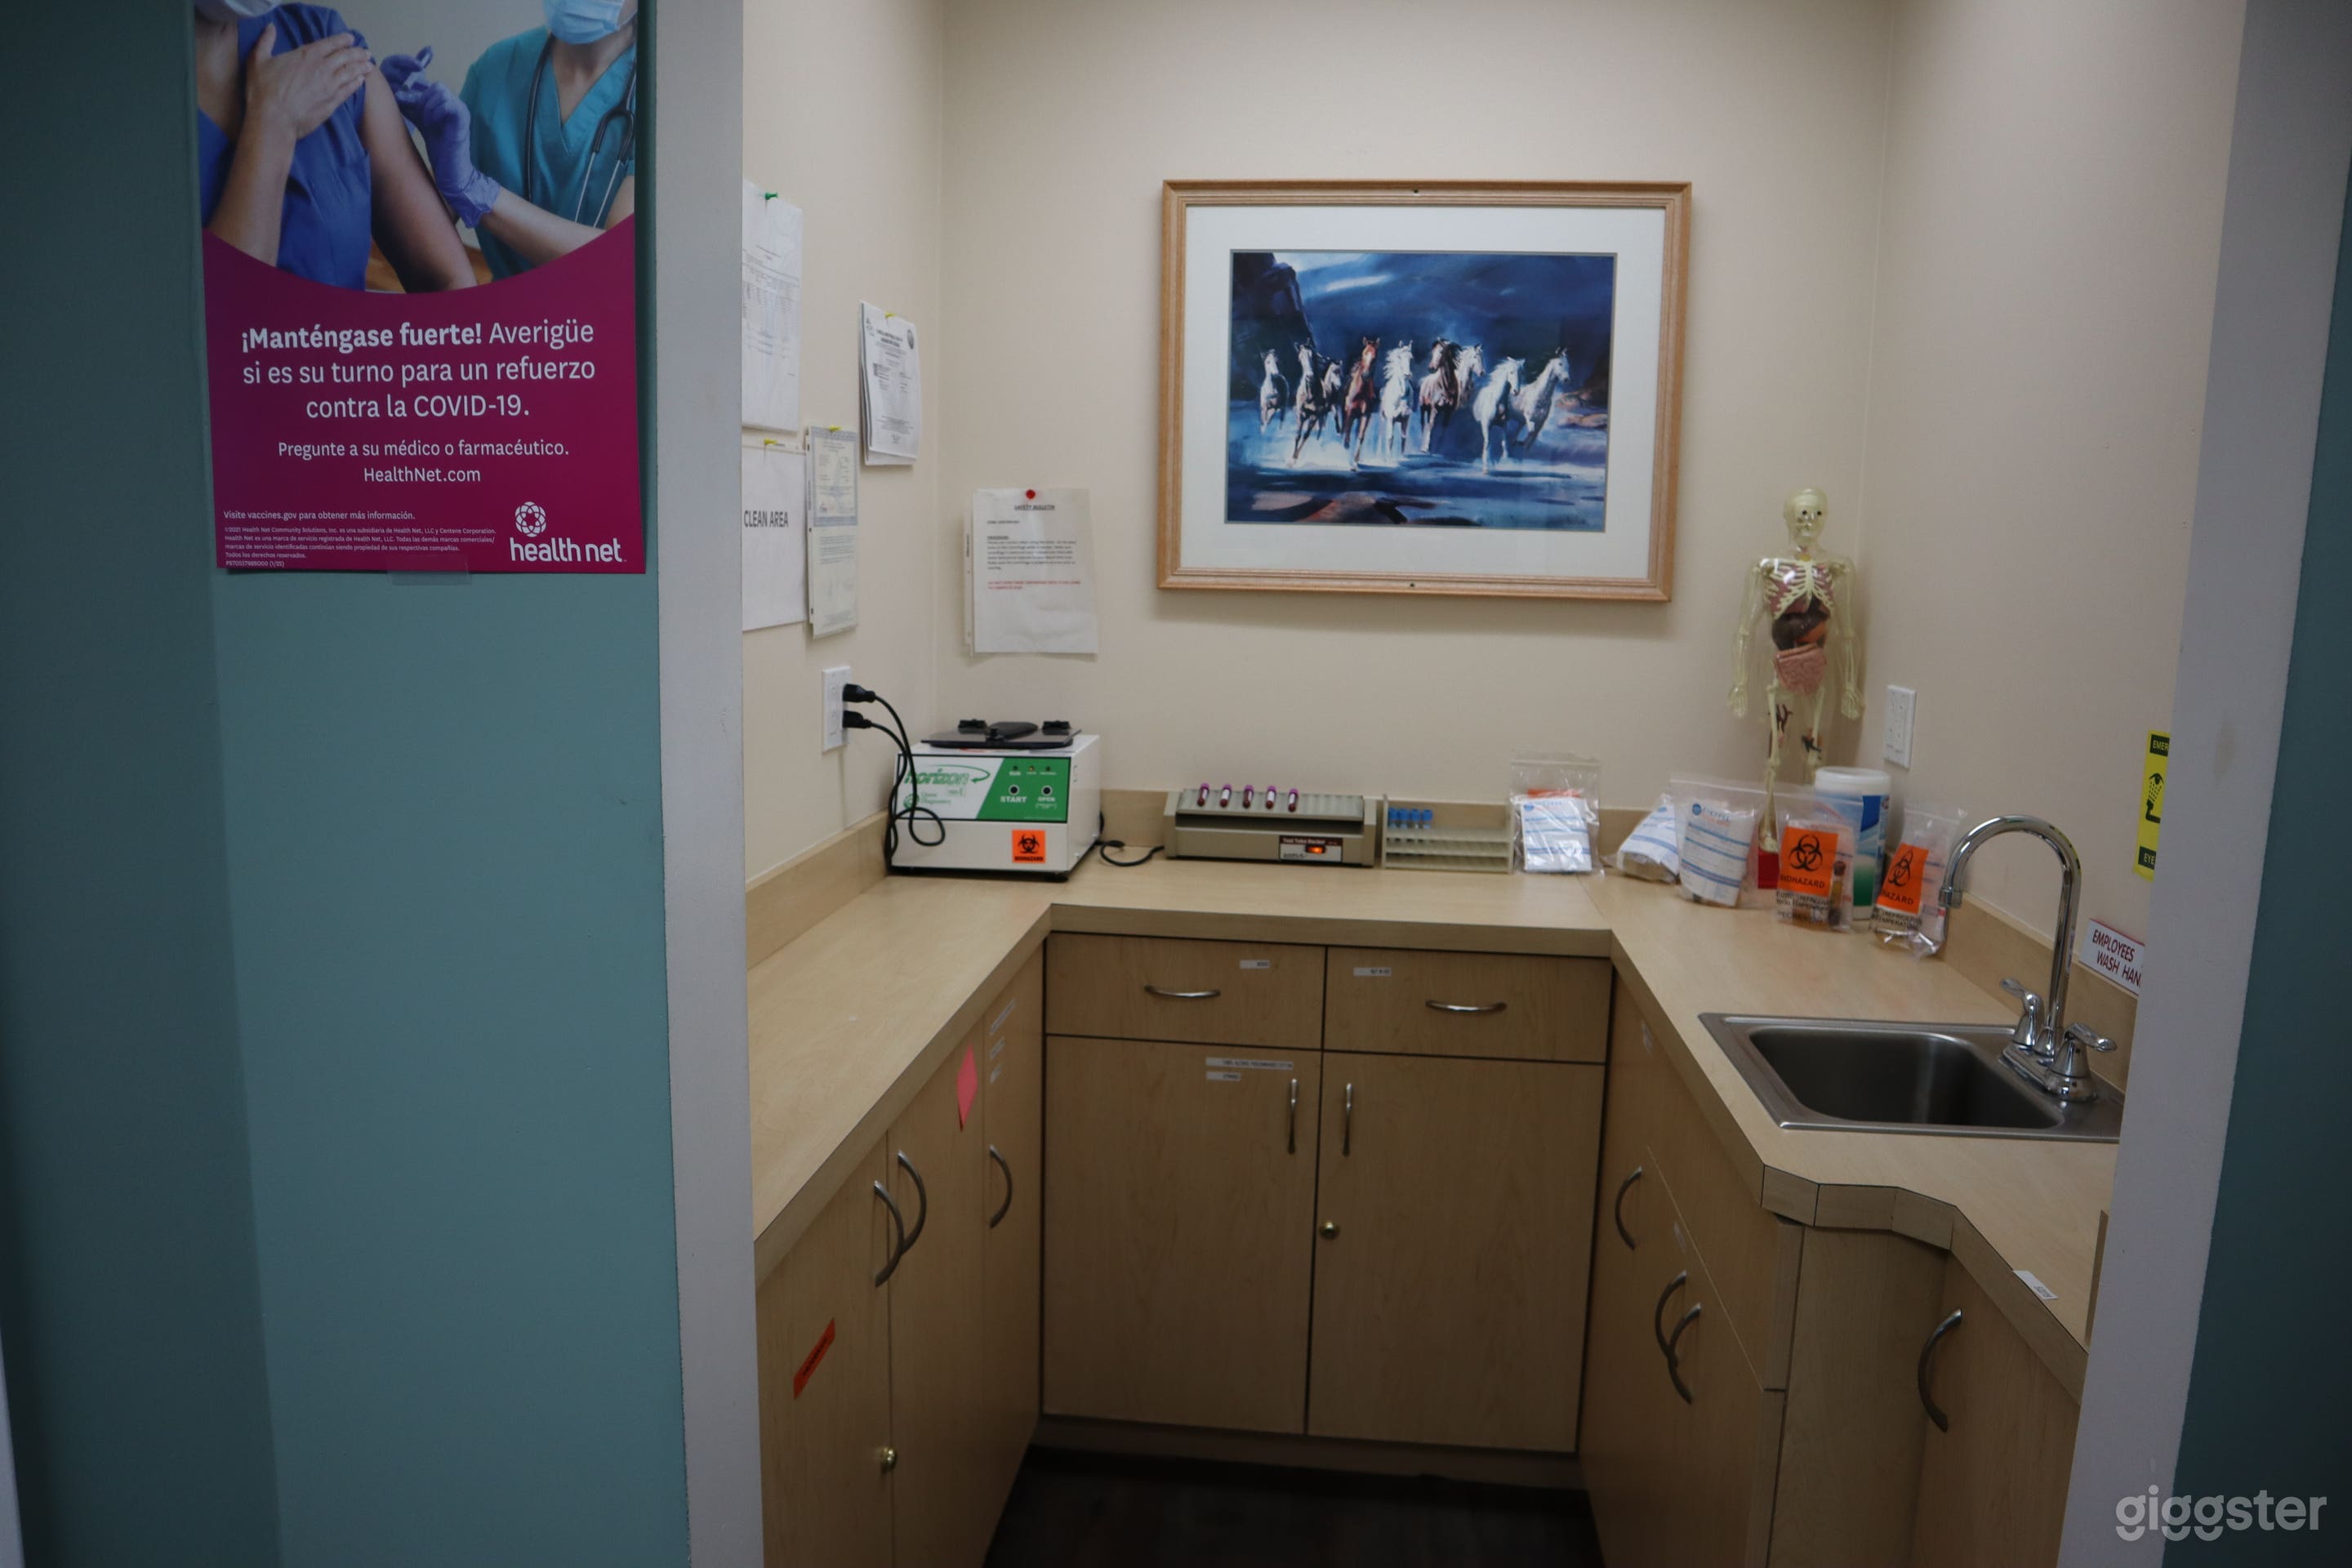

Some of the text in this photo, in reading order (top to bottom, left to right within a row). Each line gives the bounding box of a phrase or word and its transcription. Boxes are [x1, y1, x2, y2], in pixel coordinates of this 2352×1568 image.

[242, 318, 594, 354] ¡Manténgase fuerte! Averigüe
[243, 355, 595, 388] si es su turno para un refuerzo
[306, 394, 529, 418] contra la COVID-19.
[278, 439, 569, 461] Pregunte a su médico o farmacéutico.
[363, 466, 481, 483] HealthNet.com
[224, 510, 416, 521] Visite vaccines.gov para obtener más información.
[743, 510, 789, 528] CLEAN AREA
[510, 537, 623, 563] health net
[2092, 929, 2135, 962] EMPLOYEES
[2096, 950, 2121, 973] WASH
[2122, 964, 2141, 987] HAN
